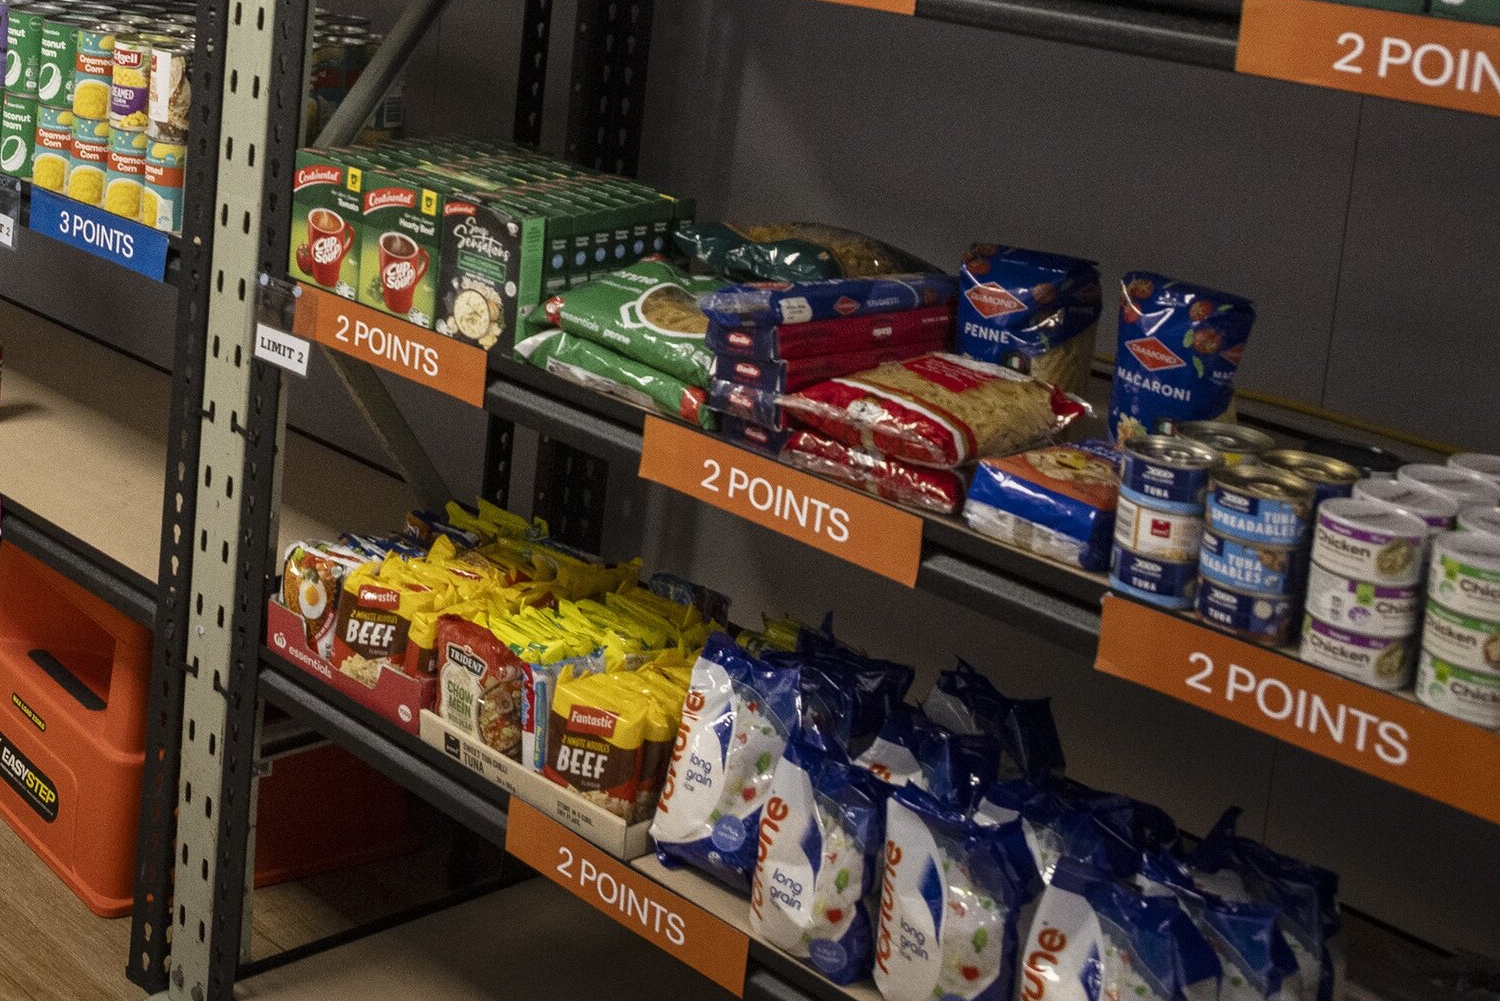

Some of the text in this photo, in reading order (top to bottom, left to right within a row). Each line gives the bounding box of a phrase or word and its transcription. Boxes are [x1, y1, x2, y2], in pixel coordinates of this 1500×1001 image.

[1332, 31, 1364, 74] 2
[38, 129, 71, 141] Creamed
[43, 139, 62, 148] Corn
[299, 169, 339, 184] Continental
[369, 192, 413, 207] Continental
[5, 226, 10, 236] 2
[59, 211, 134, 258] 3 POINTS
[335, 315, 439, 376] 2 POINTS
[964, 322, 1009, 344] PENNE
[261, 337, 304, 364] LIMIT 2
[1118, 367, 1191, 401] MACARONI
[700, 459, 850, 544] 2 POINTS
[1144, 485, 1169, 498] TUNA
[1317, 528, 1371, 558] Chicken
[346, 618, 396, 647] BEEF
[289, 646, 332, 679] essentials
[450, 648, 484, 674] TRIDENT
[1310, 635, 1370, 664] Chicken
[448, 680, 474, 700] CHOW
[448, 696, 472, 717] MEIN
[571, 711, 613, 729] Fantastic
[1184, 652, 1409, 766] 2 POINTS
[1, 746, 56, 803] EASYSTEP
[557, 745, 608, 779] BEEF
[691, 753, 712, 774] long
[686, 769, 712, 788] grain
[556, 847, 686, 947] 2 POINTS
